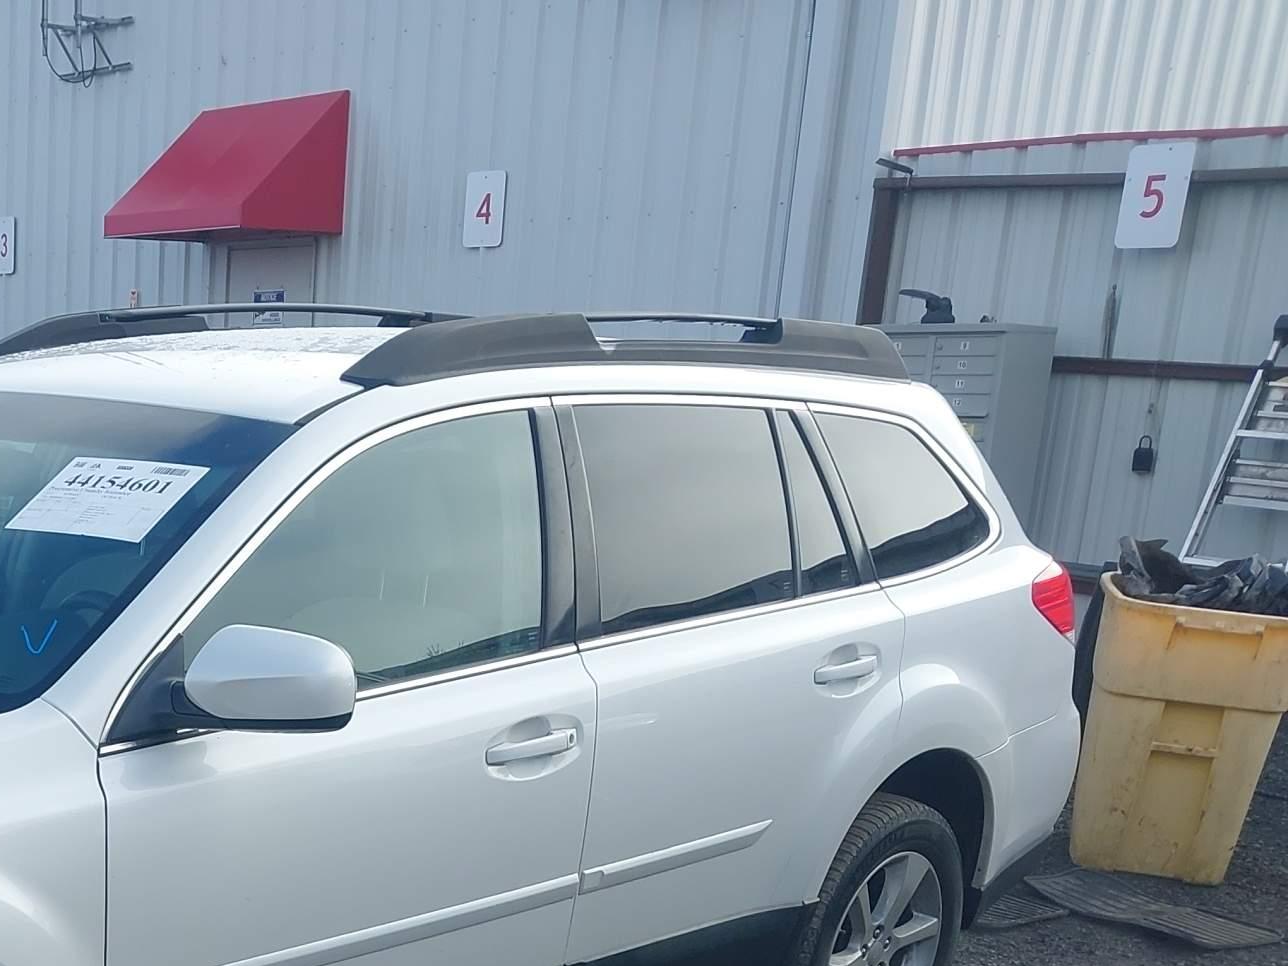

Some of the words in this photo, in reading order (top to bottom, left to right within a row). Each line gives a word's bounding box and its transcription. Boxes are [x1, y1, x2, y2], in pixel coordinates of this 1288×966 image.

[476, 192, 491, 225] 4
[1139, 174, 1167, 218] 5
[0, 232, 8, 258] 3
[64, 473, 173, 495] 44154601
